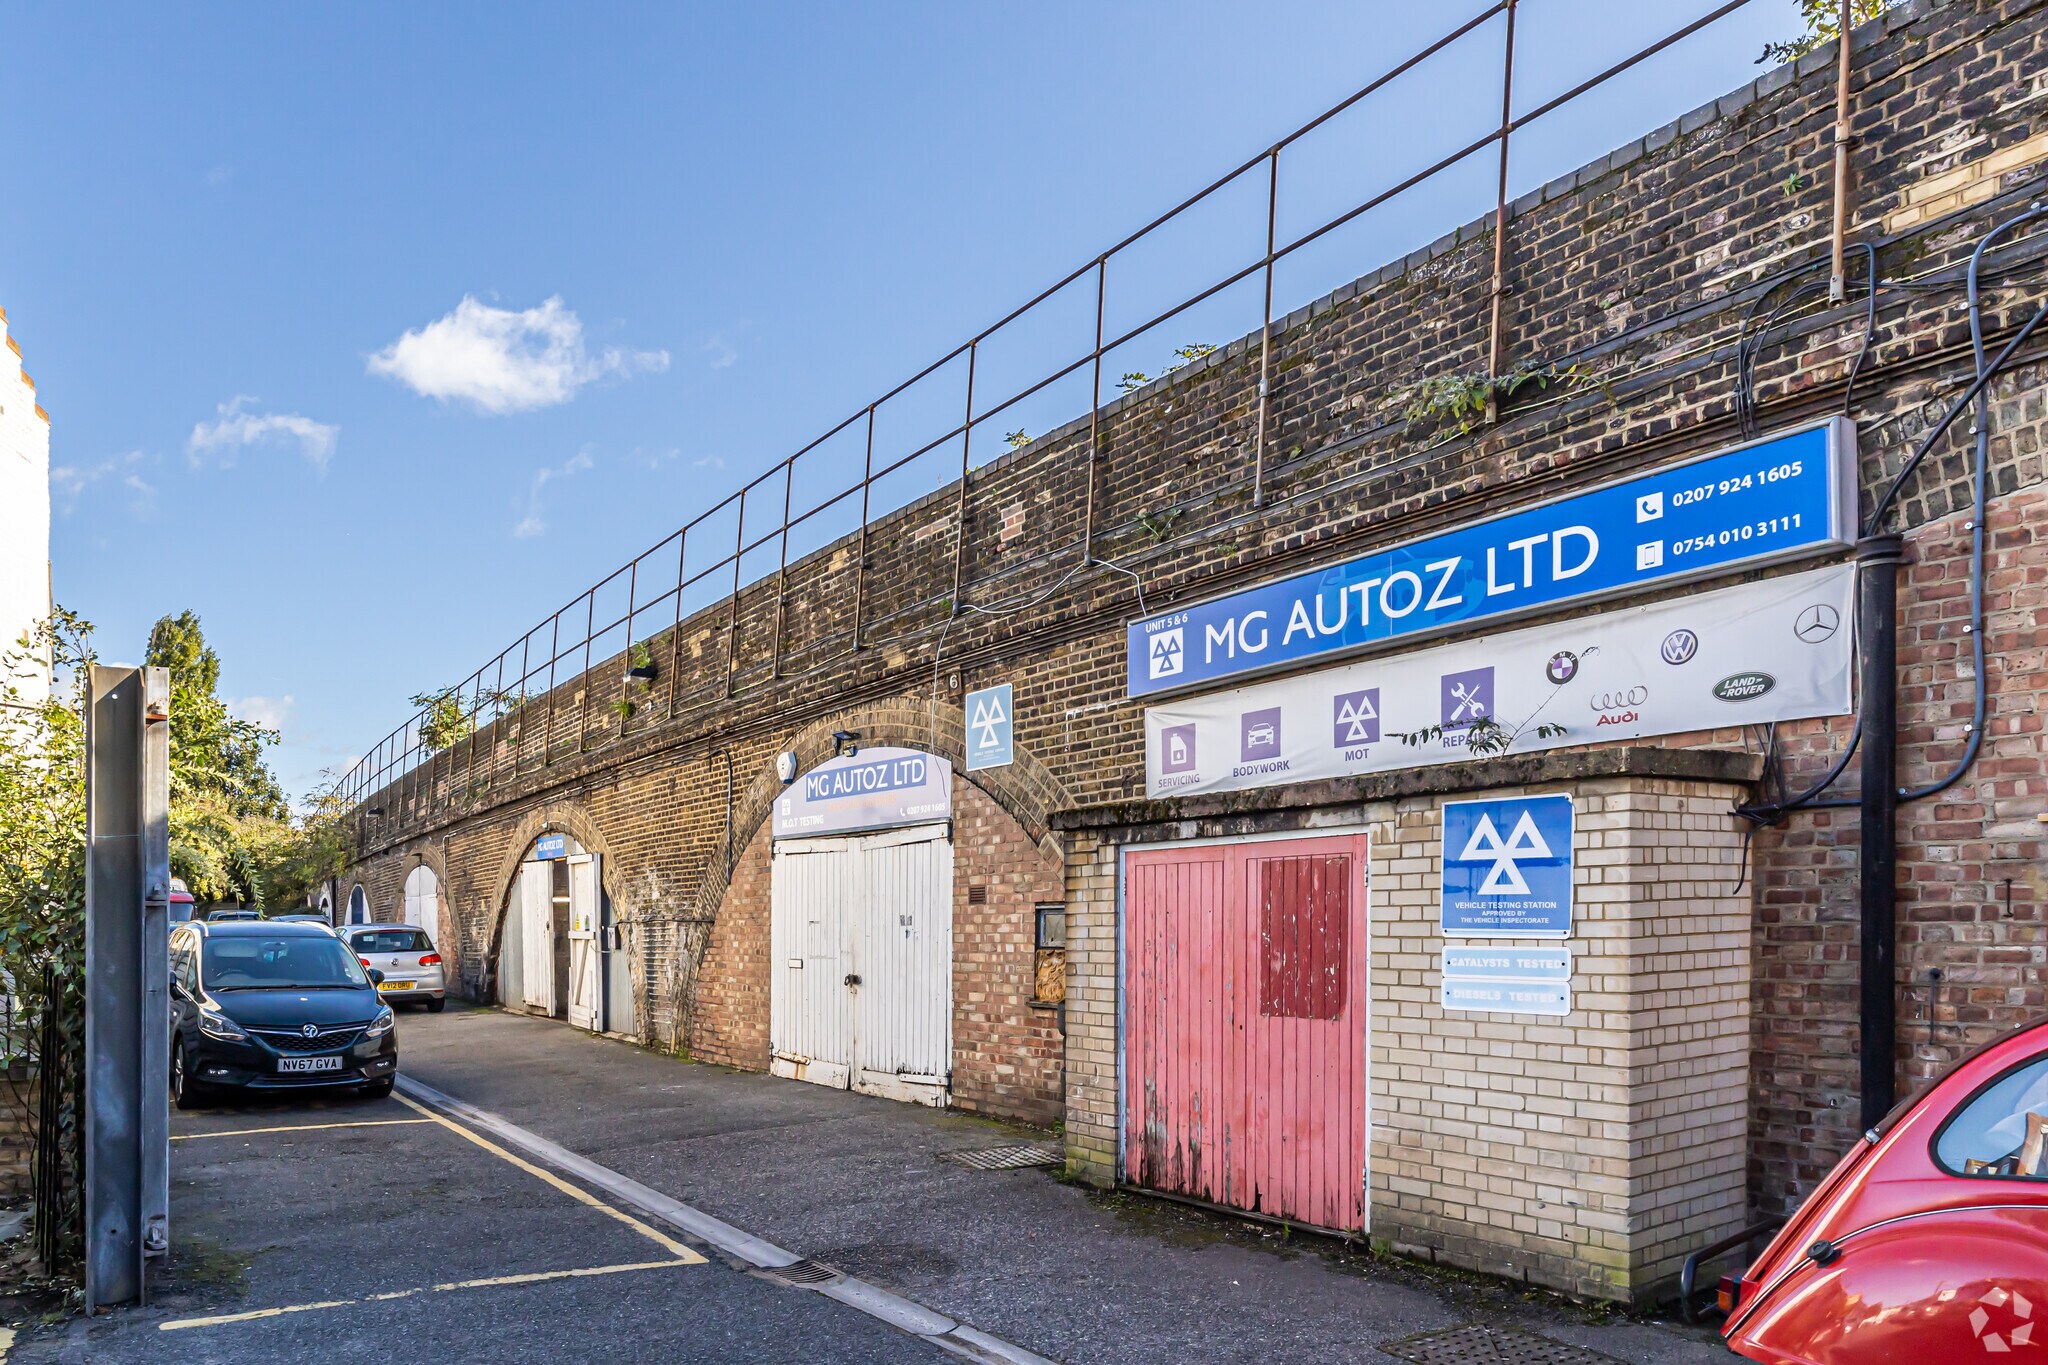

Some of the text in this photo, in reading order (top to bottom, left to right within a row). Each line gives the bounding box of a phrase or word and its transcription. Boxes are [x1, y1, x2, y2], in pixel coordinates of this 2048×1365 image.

[1672, 461, 1802, 507] 0207 924 1605
[1672, 513, 1801, 555] 0754 010 3111
[1205, 525, 1600, 664] MG AUTOZ LTD
[1145, 613, 1188, 633] UNIT 5 & 6
[949, 674, 958, 688] 6
[1726, 684, 1765, 697] ROVER
[1596, 711, 1639, 726] Audi
[1345, 748, 1370, 762] MOT
[1233, 760, 1290, 777] BODYWORK
[807, 759, 925, 798] MG AUTOZ LTD
[1158, 773, 1200, 788] SERVICING
[799, 814, 824, 827] TESTING
[1450, 958, 1562, 969] CATALYSTS TESTED
[1453, 989, 1501, 1000] DIESELS
[283, 1058, 337, 1070] NV67 GVA
